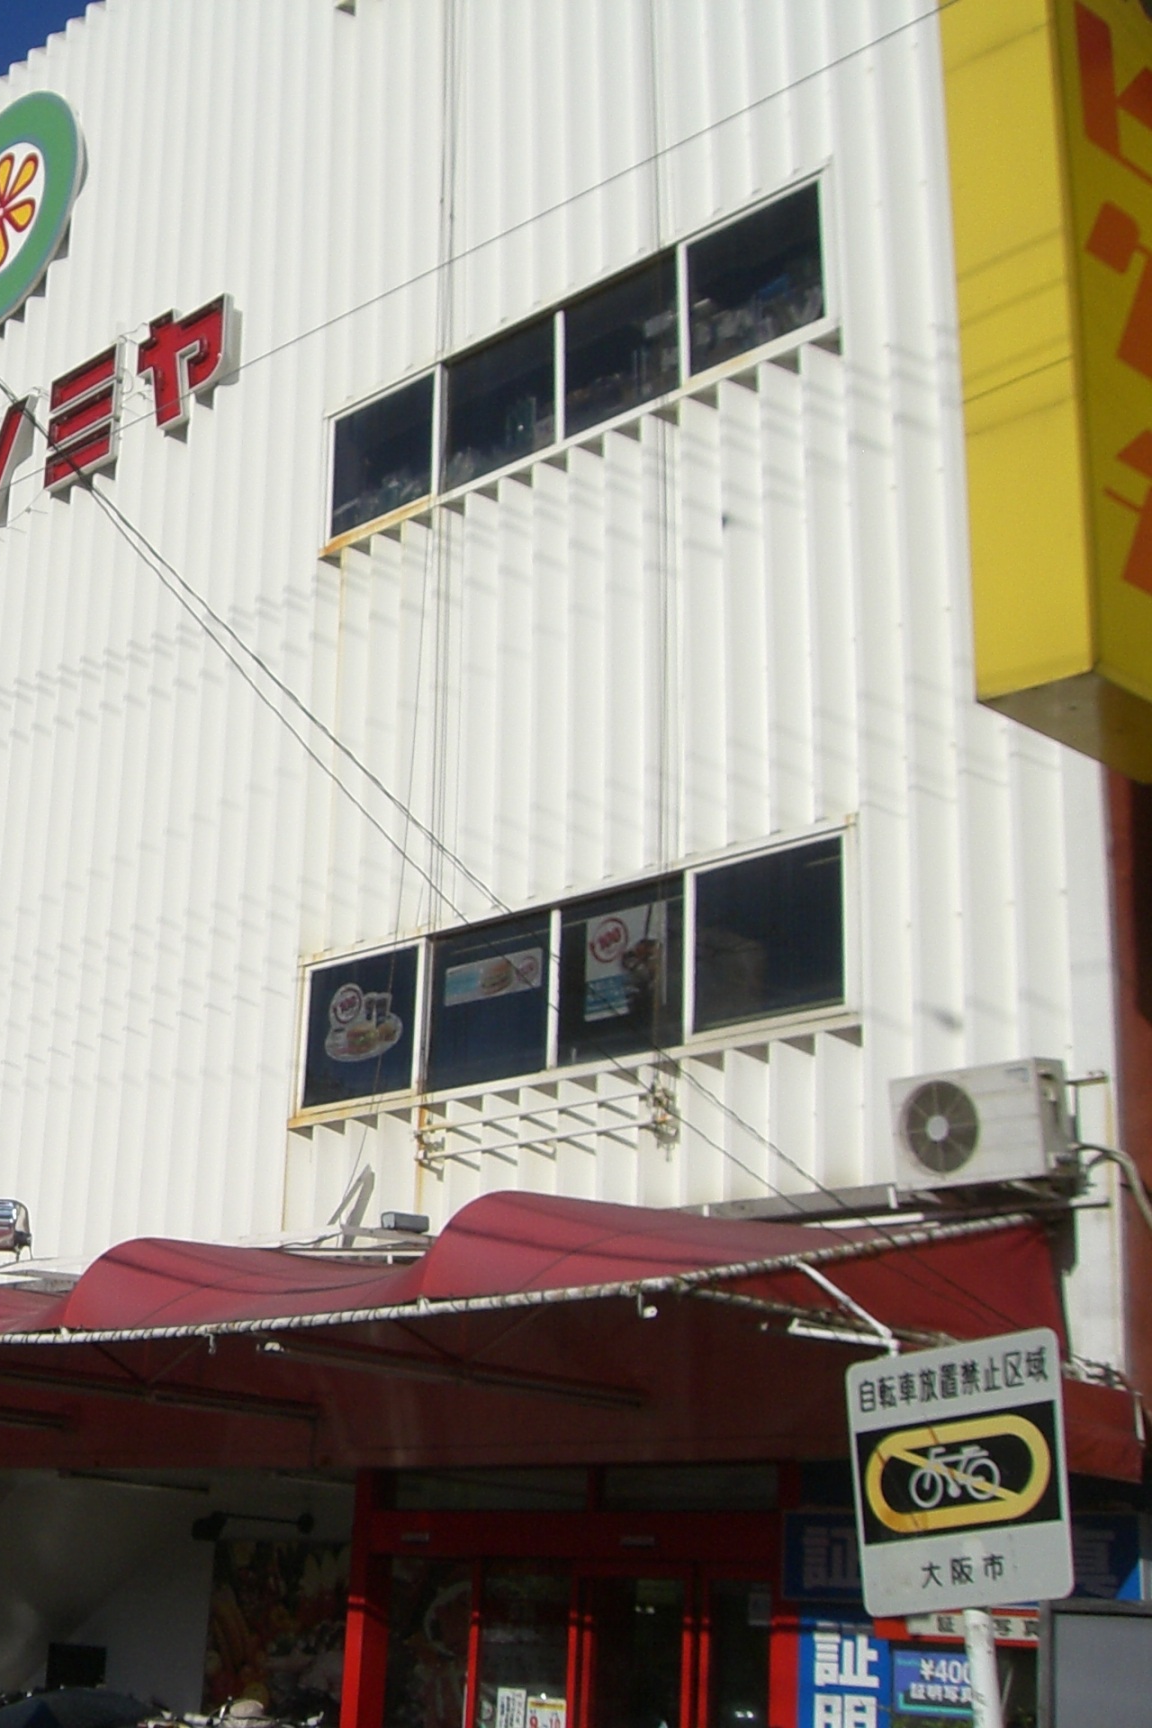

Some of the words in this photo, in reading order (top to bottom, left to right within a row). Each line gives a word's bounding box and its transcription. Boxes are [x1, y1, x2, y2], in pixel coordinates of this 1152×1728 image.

[859, 1347, 1048, 1413] 自転車放置禁止区域
[920, 1554, 1005, 1589] 大阪市
